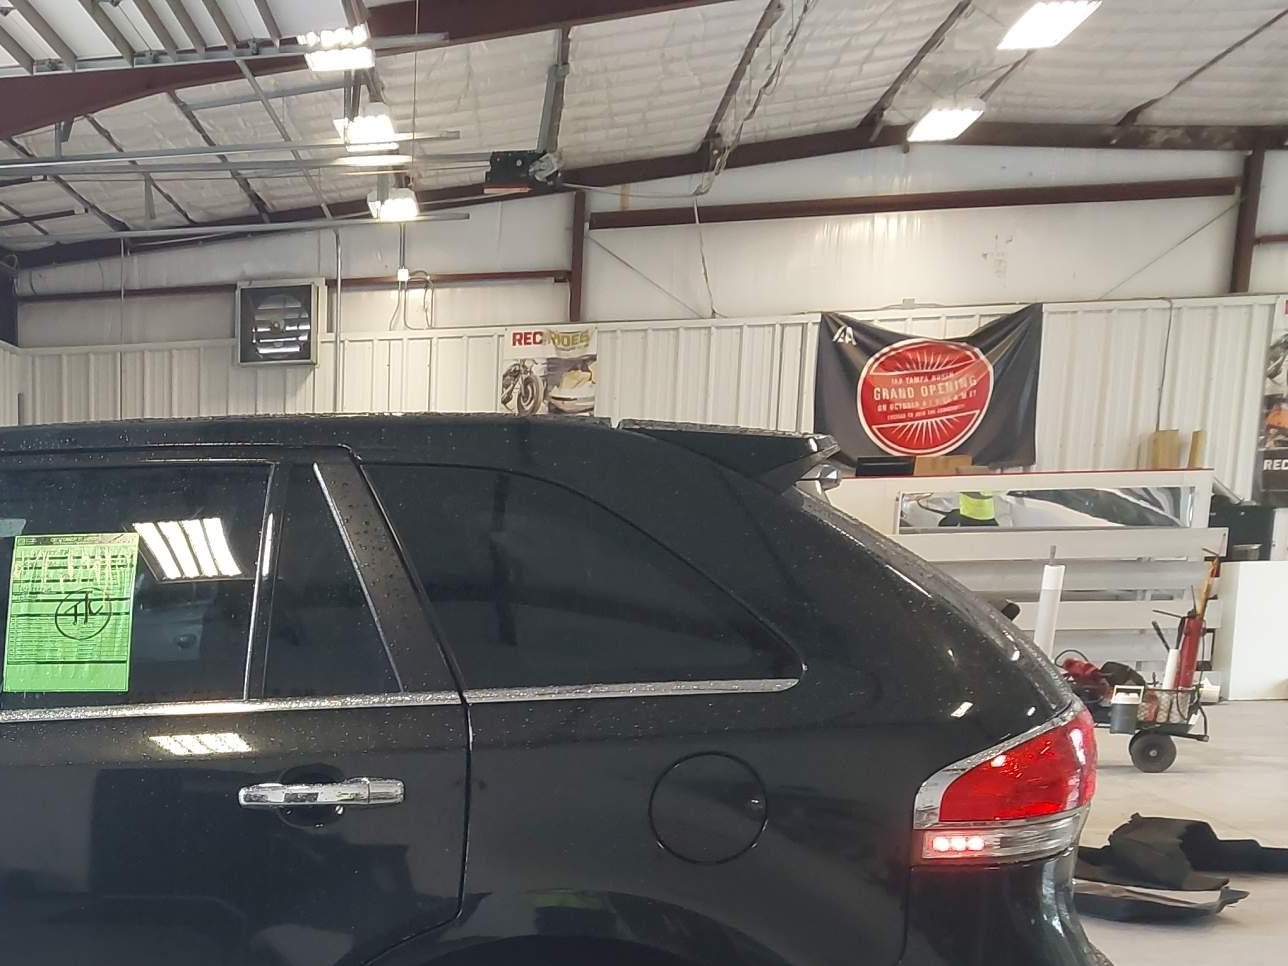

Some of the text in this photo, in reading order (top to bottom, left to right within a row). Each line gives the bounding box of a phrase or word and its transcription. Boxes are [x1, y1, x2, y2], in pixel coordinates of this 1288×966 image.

[512, 331, 544, 346] REC
[905, 374, 929, 384] TAMPA
[873, 386, 915, 401] GRAND
[920, 375, 977, 398] OPENING
